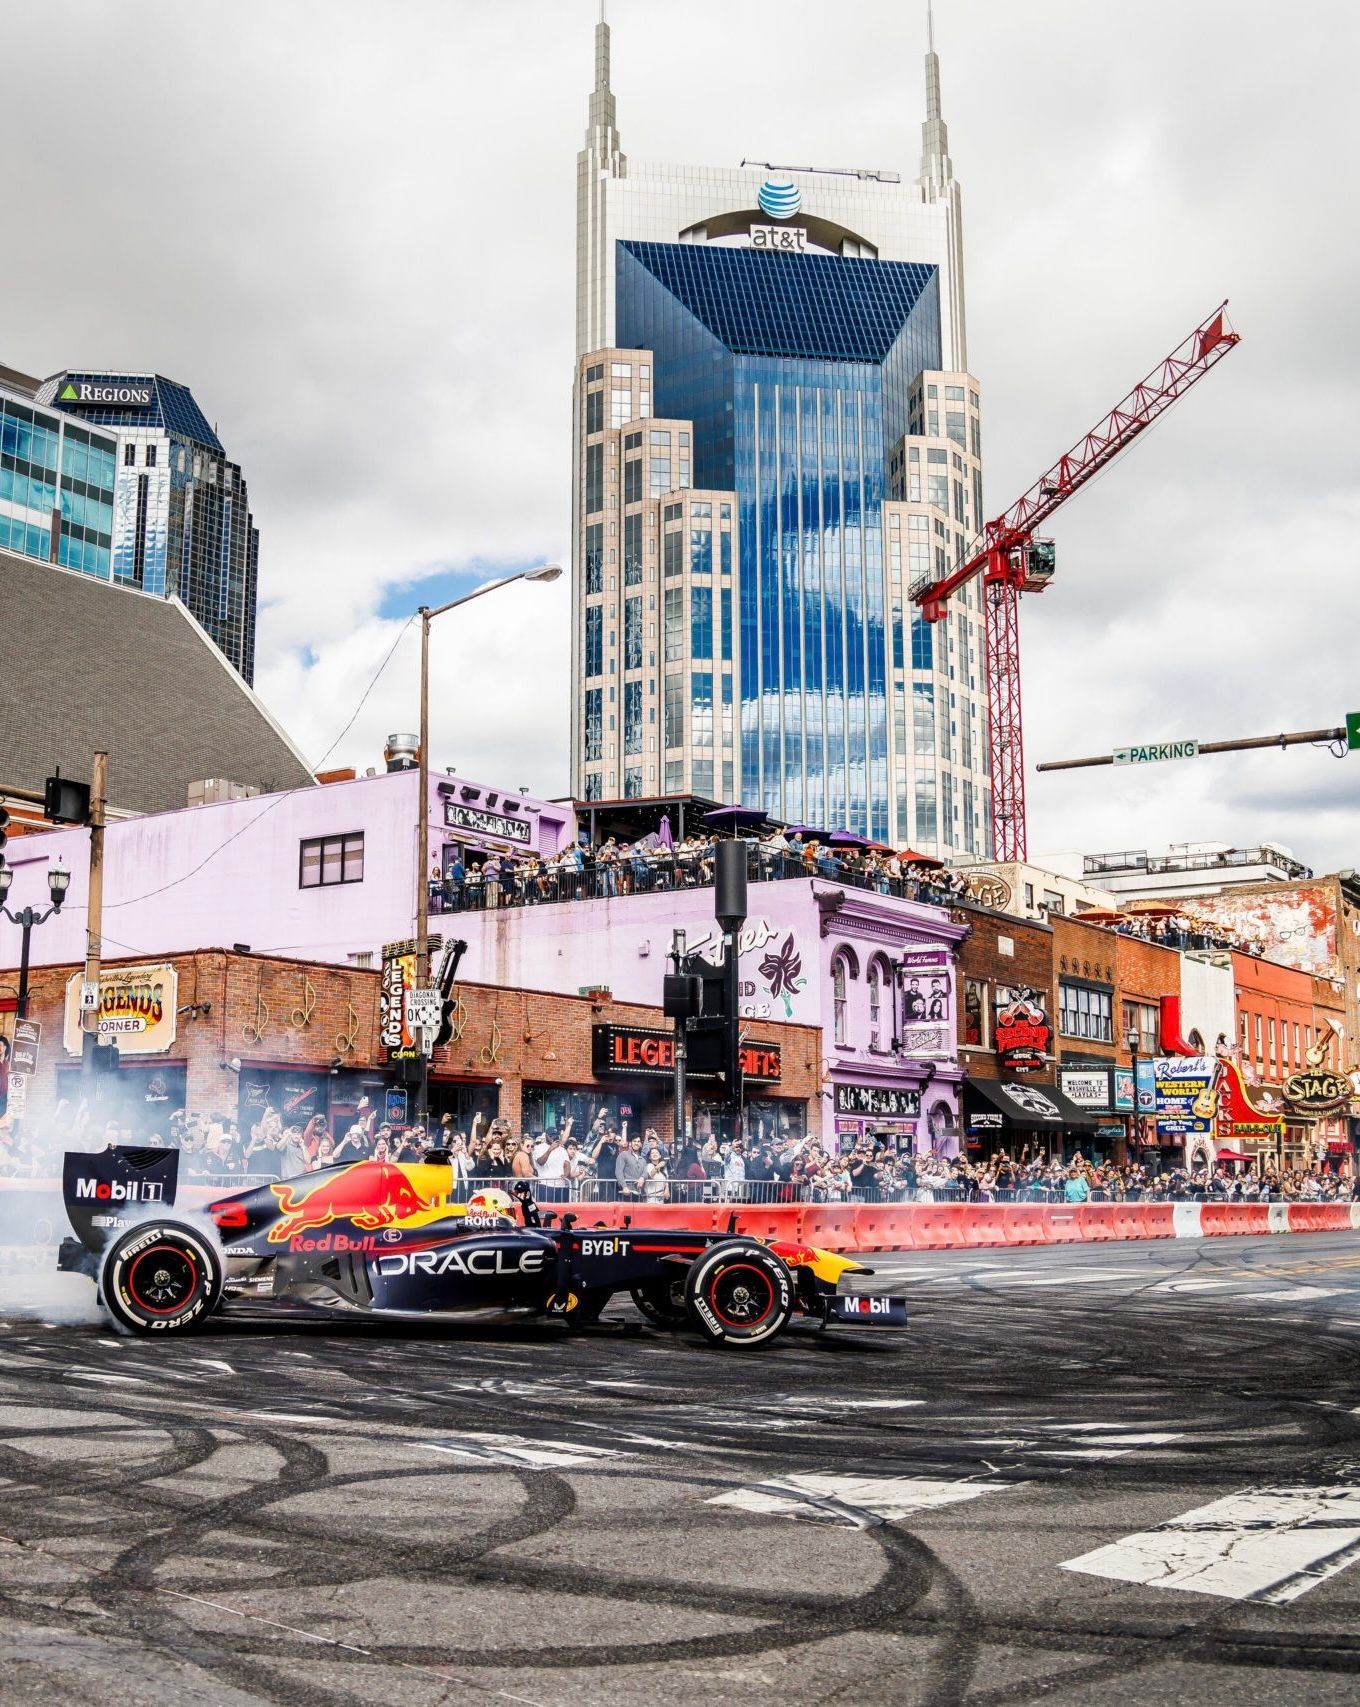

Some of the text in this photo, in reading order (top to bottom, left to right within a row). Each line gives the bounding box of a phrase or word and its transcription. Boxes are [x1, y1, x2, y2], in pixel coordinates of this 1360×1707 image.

[753, 226, 805, 252] at&t
[80, 384, 149, 403] REGIONS
[1130, 742, 1195, 762] PARKING
[389, 957, 403, 1047] LEGENDS
[409, 991, 437, 999] DIAGONAL
[407, 1008, 421, 1022] OK
[1158, 1057, 1207, 1080] Robert's
[1156, 1080, 1206, 1088] WESTERN
[1161, 1088, 1200, 1096] WORLD
[1287, 1075, 1349, 1101] STAGE
[1156, 1097, 1188, 1105] HOME
[76, 1177, 139, 1201] Mobil
[464, 1215, 498, 1228] ROKT
[120, 1230, 163, 1262] PIRELLI
[290, 1233, 376, 1253] Red Bull
[582, 1237, 630, 1257] BYBIT
[372, 1250, 545, 1276] ORACLE
[745, 1249, 789, 1308] P ZERO
[151, 1280, 212, 1329] P ZERO
[844, 1296, 890, 1314] Mobil
[693, 1297, 724, 1336] PIRELLI
